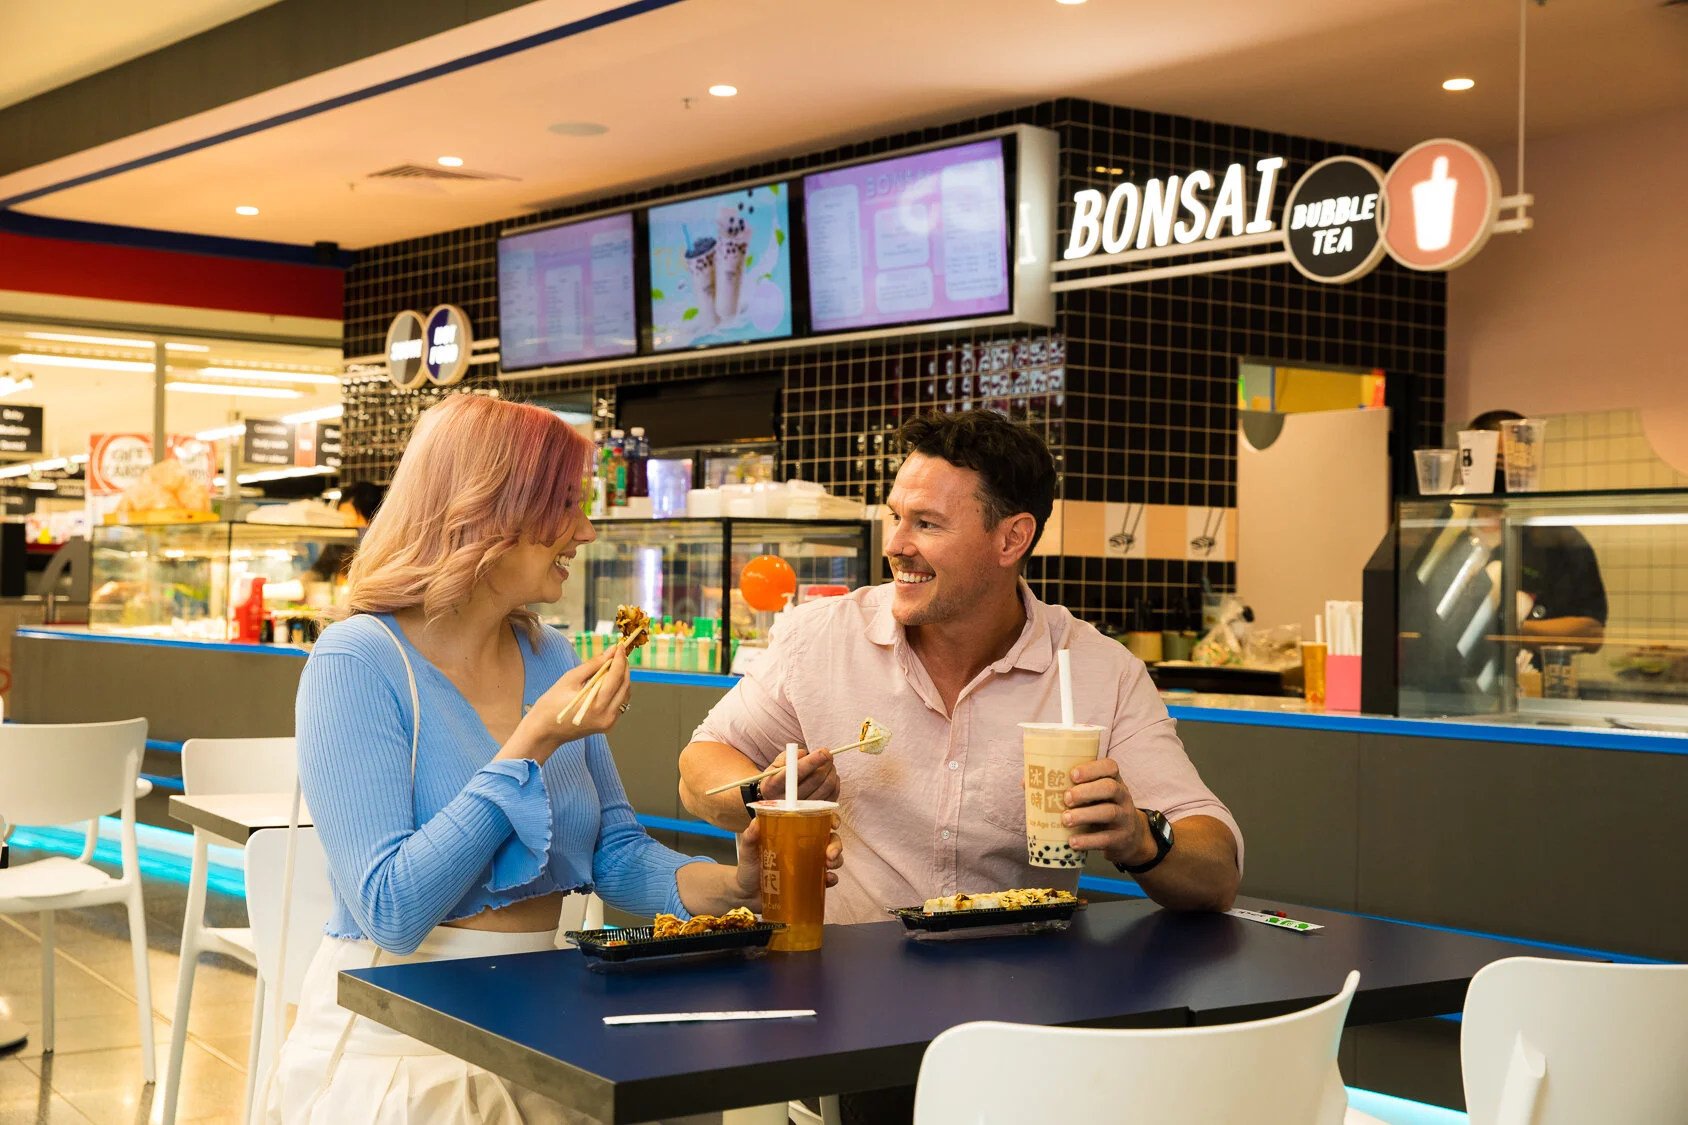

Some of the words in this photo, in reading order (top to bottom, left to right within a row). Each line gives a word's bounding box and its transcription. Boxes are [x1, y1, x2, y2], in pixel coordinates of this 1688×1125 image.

[1063, 157, 1284, 260] BONSAI
[1290, 193, 1378, 230] BUBBLE
[1312, 226, 1353, 256] TEA
